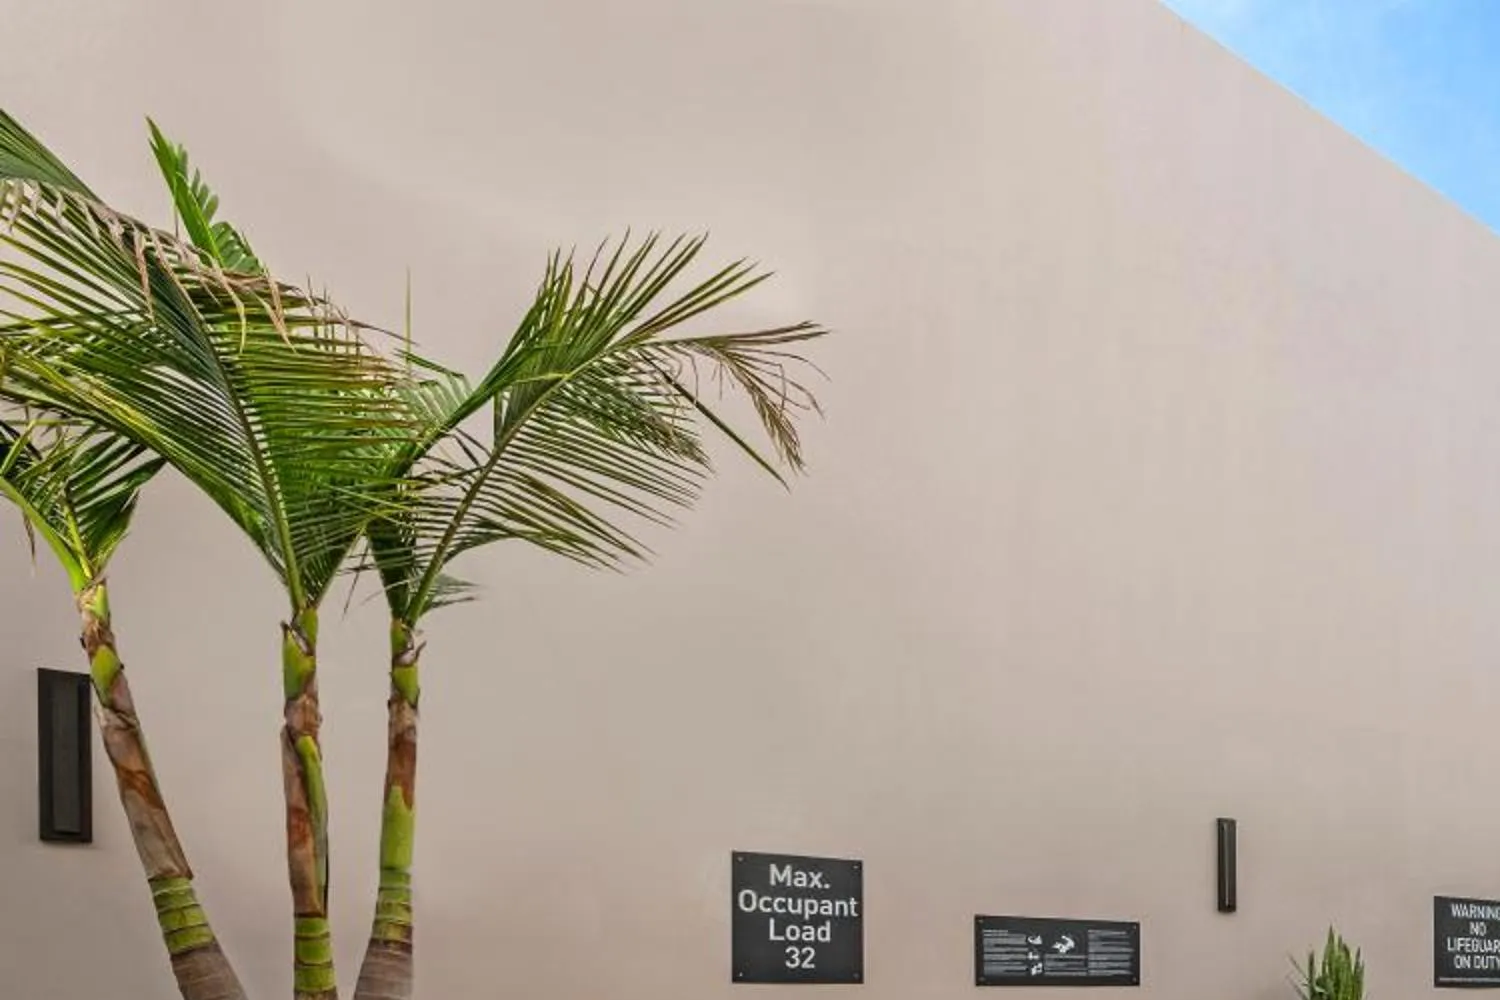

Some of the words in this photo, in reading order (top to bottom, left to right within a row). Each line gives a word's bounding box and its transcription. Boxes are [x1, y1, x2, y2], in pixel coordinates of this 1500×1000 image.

[769, 863, 831, 889] Max.
[738, 889, 859, 920] Occupant
[769, 917, 831, 942] Load
[1469, 921, 1487, 936] NO
[785, 946, 816, 969] 32
[1453, 955, 1471, 969] ON
